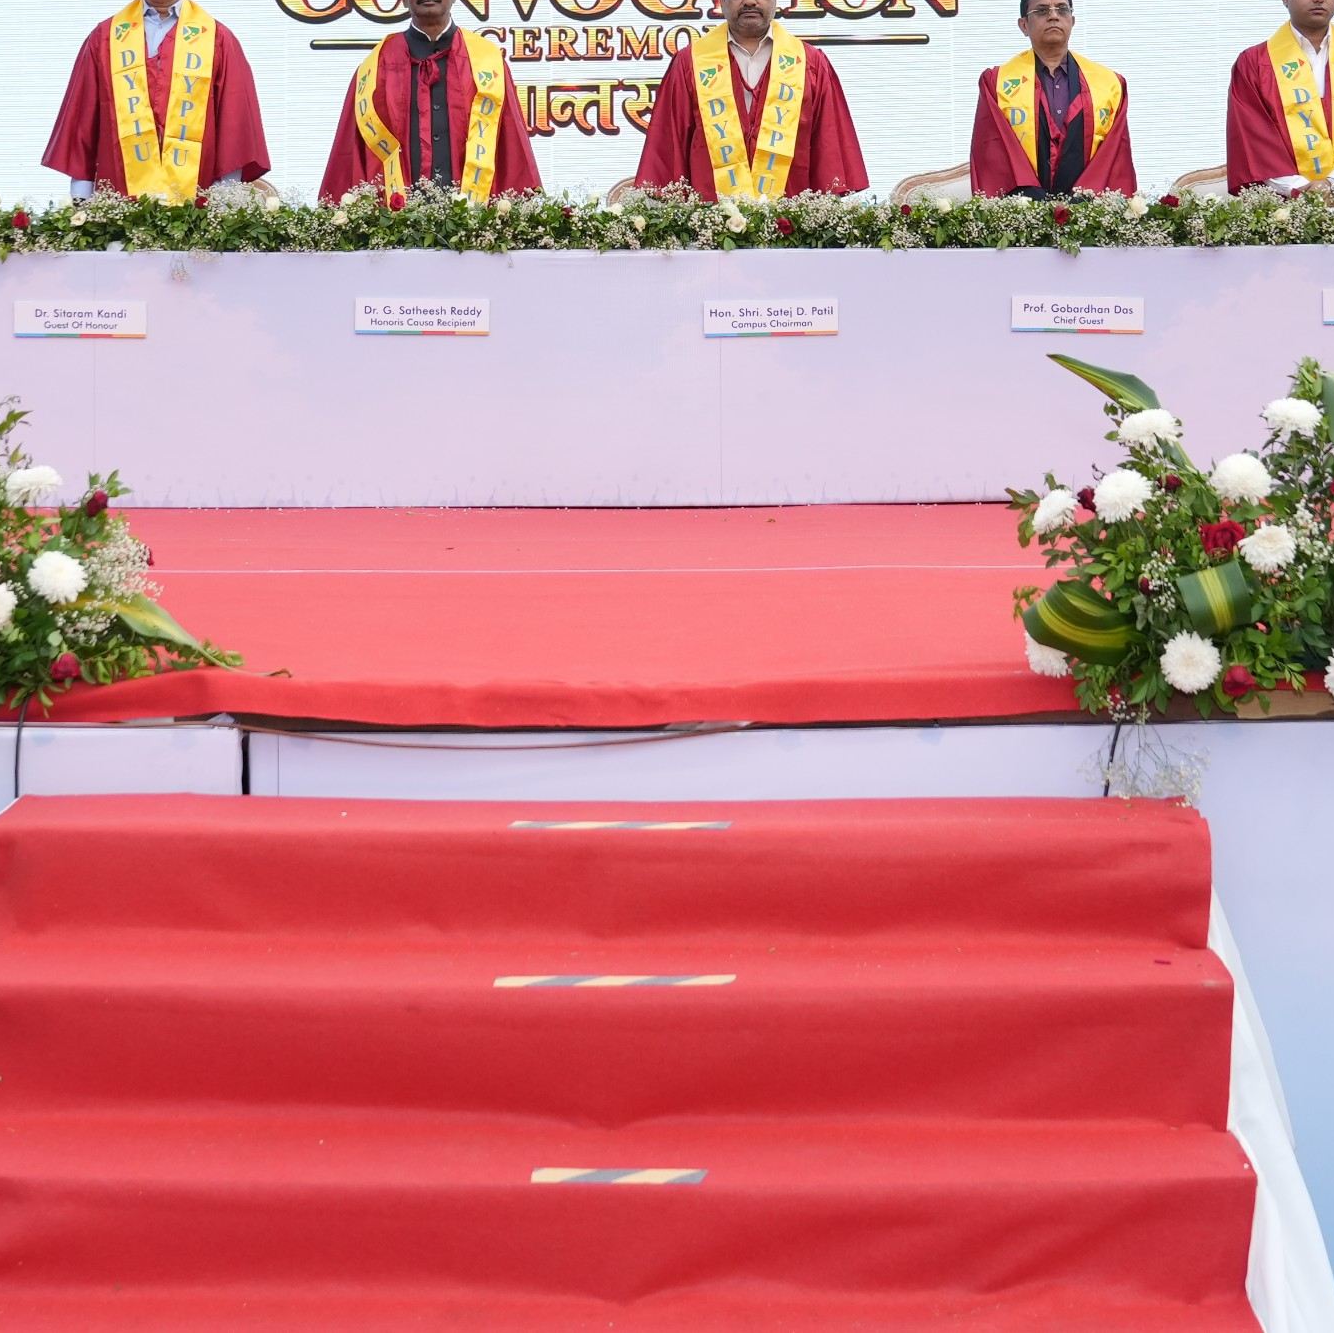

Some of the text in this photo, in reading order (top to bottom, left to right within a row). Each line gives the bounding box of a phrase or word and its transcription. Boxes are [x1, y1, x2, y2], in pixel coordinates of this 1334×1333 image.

[474, 25, 715, 62] CEREMO
[121, 50, 151, 161] DYPIU
[173, 53, 201, 166] DYPIU
[35, 309, 127, 318] Dr. Sitaram Kandi
[364, 306, 482, 318] Dr. G. Satheesh Reddy
[710, 306, 833, 317] Hon. Shri. Satej D. Patil
[1023, 303, 1134, 314] Prof. Gobardhan Das
[44, 321, 118, 330] Guest Of Honour
[371, 318, 476, 328] Honoris Causa Recipient
[732, 321, 767, 329] Campus
[1054, 316, 1104, 325] Chief Guest
